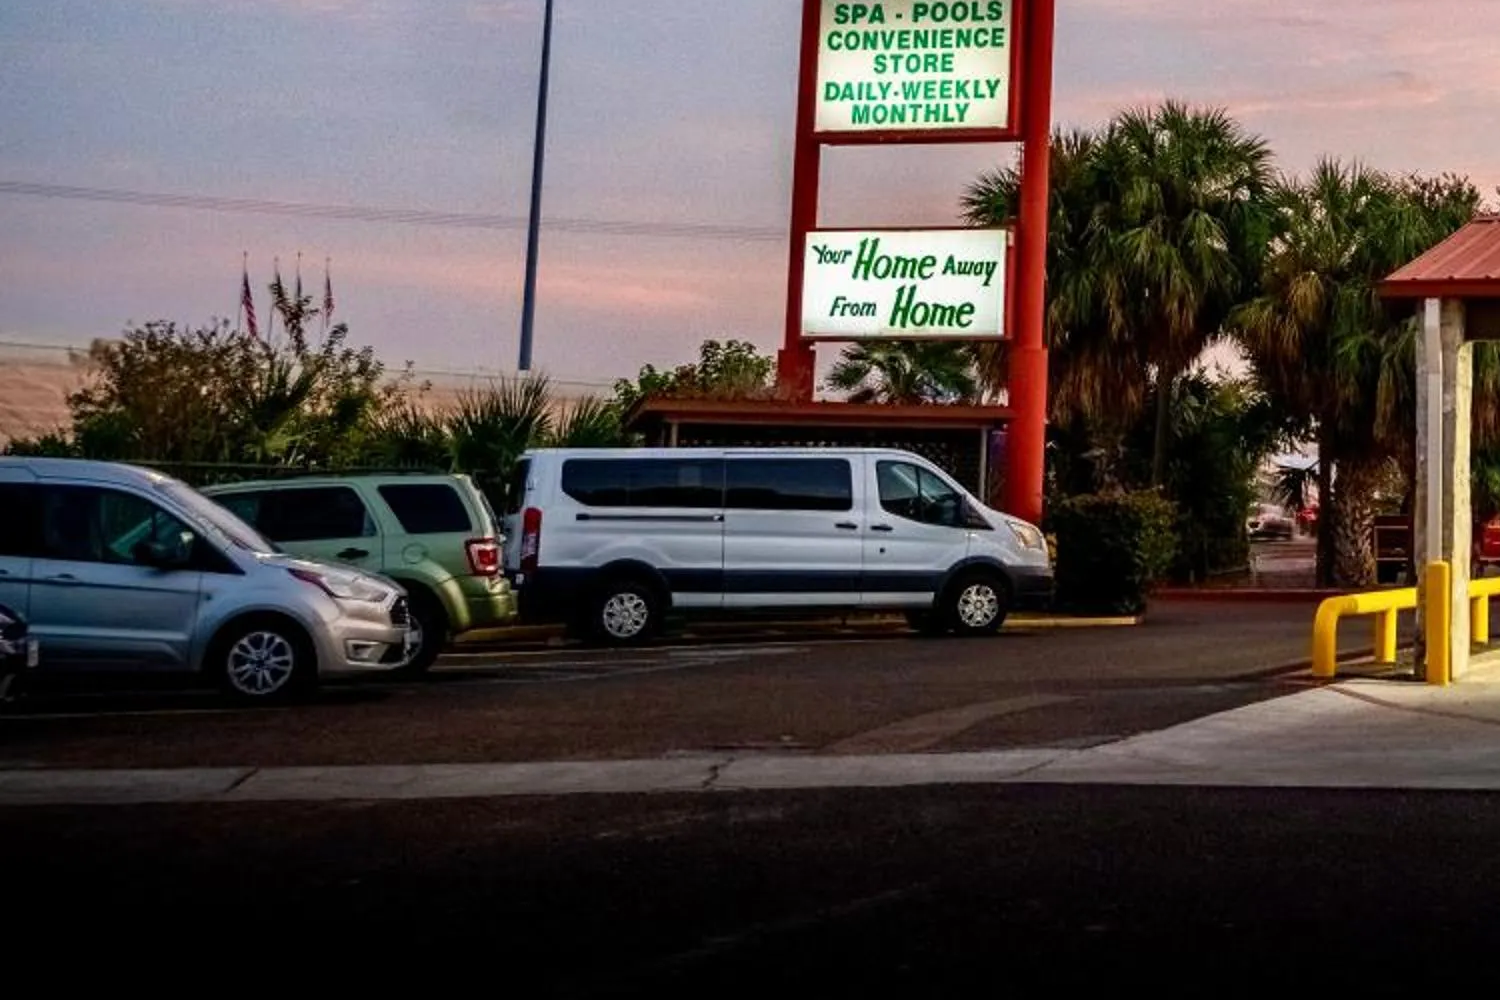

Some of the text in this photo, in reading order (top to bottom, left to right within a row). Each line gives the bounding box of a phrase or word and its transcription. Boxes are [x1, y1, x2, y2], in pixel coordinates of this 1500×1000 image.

[834, 3, 885, 24] SPA
[912, 0, 1003, 23] POOLS
[827, 27, 1006, 51] CONVENIENCE
[873, 53, 955, 74] STORE
[851, 102, 971, 125] MONTHLY
[811, 237, 998, 287] Your Home Away
[829, 284, 975, 329] From Home
